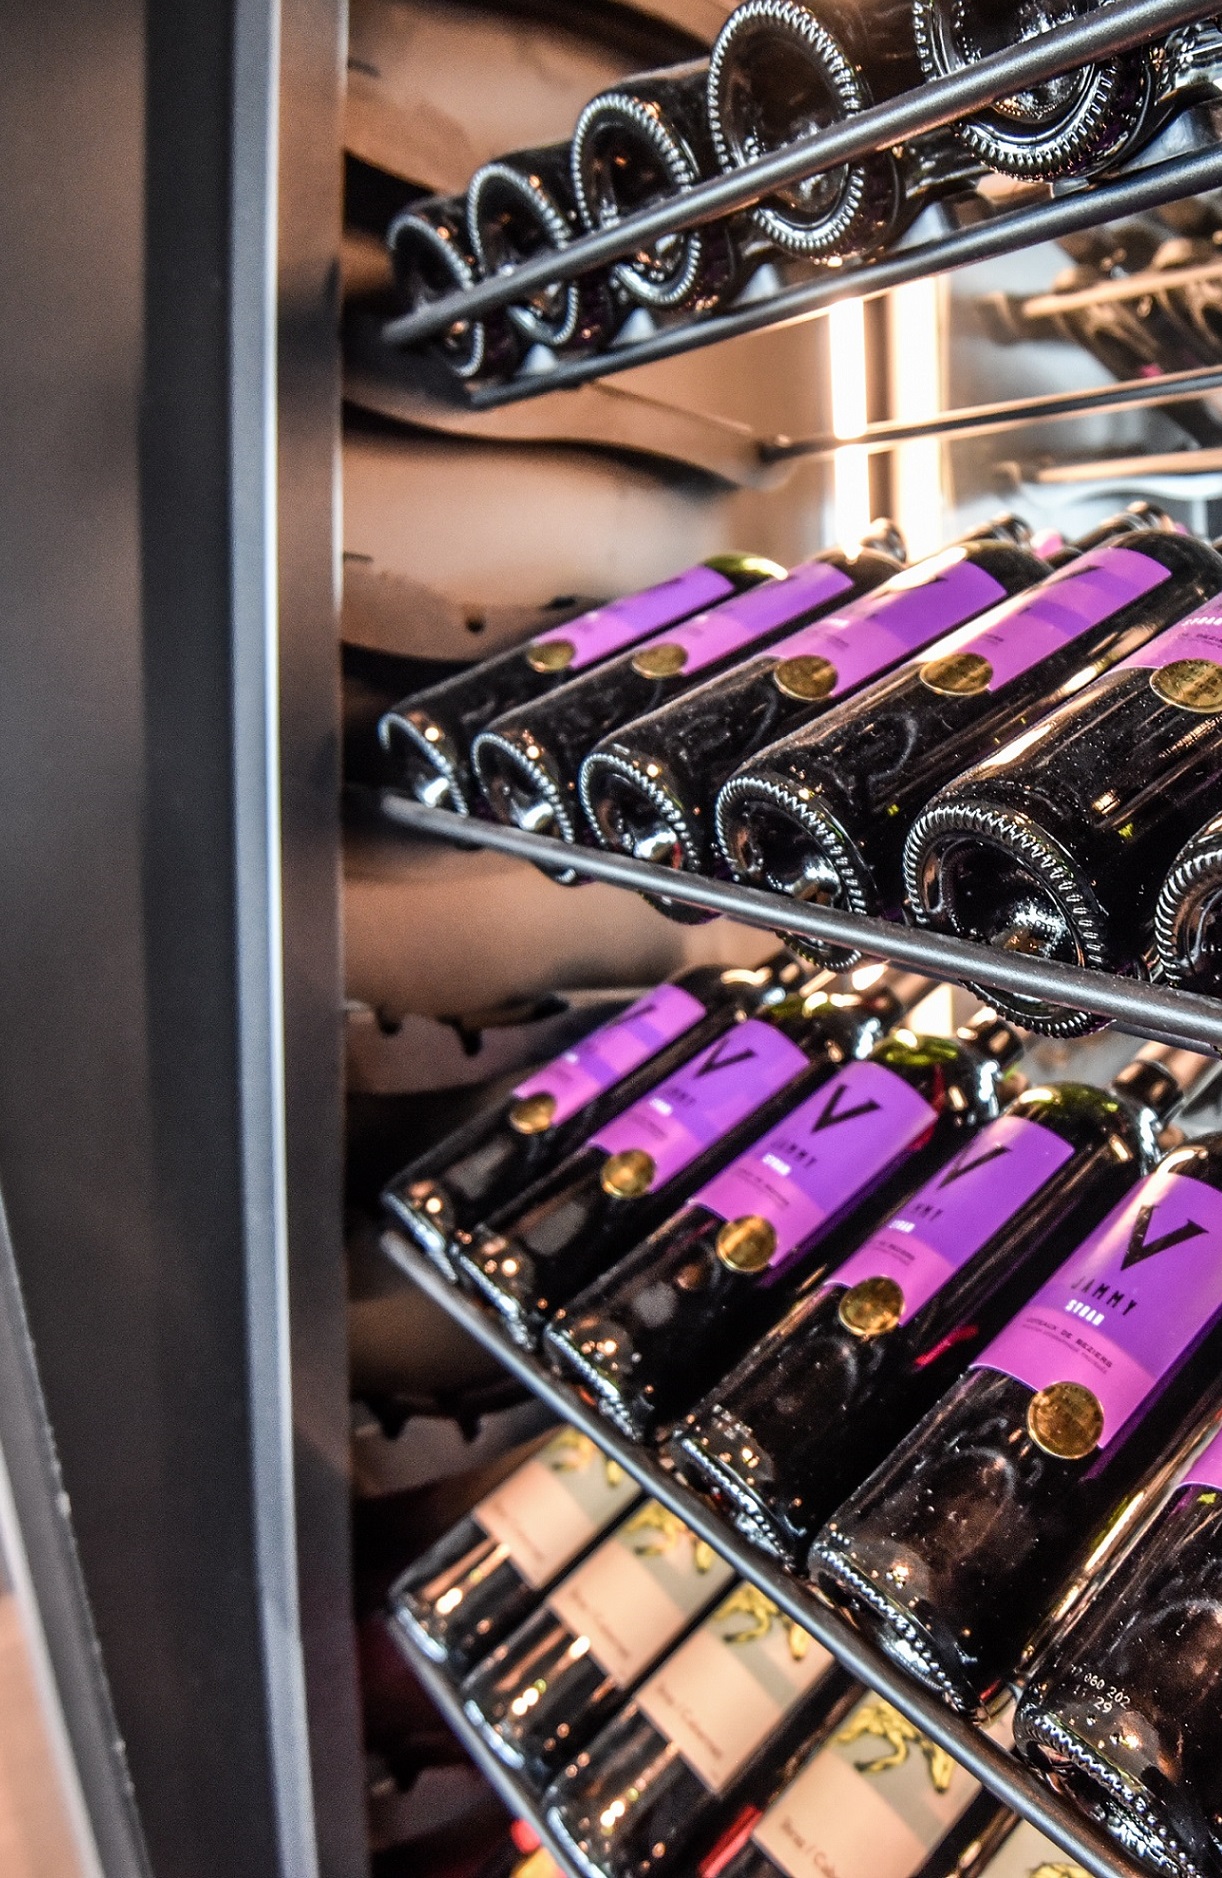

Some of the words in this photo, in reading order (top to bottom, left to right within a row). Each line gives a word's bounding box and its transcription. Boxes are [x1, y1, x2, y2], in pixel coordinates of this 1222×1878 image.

[811, 1083, 882, 1134] V
[1120, 1203, 1209, 1271] V
[1070, 1275, 1138, 1316] JAMMY
